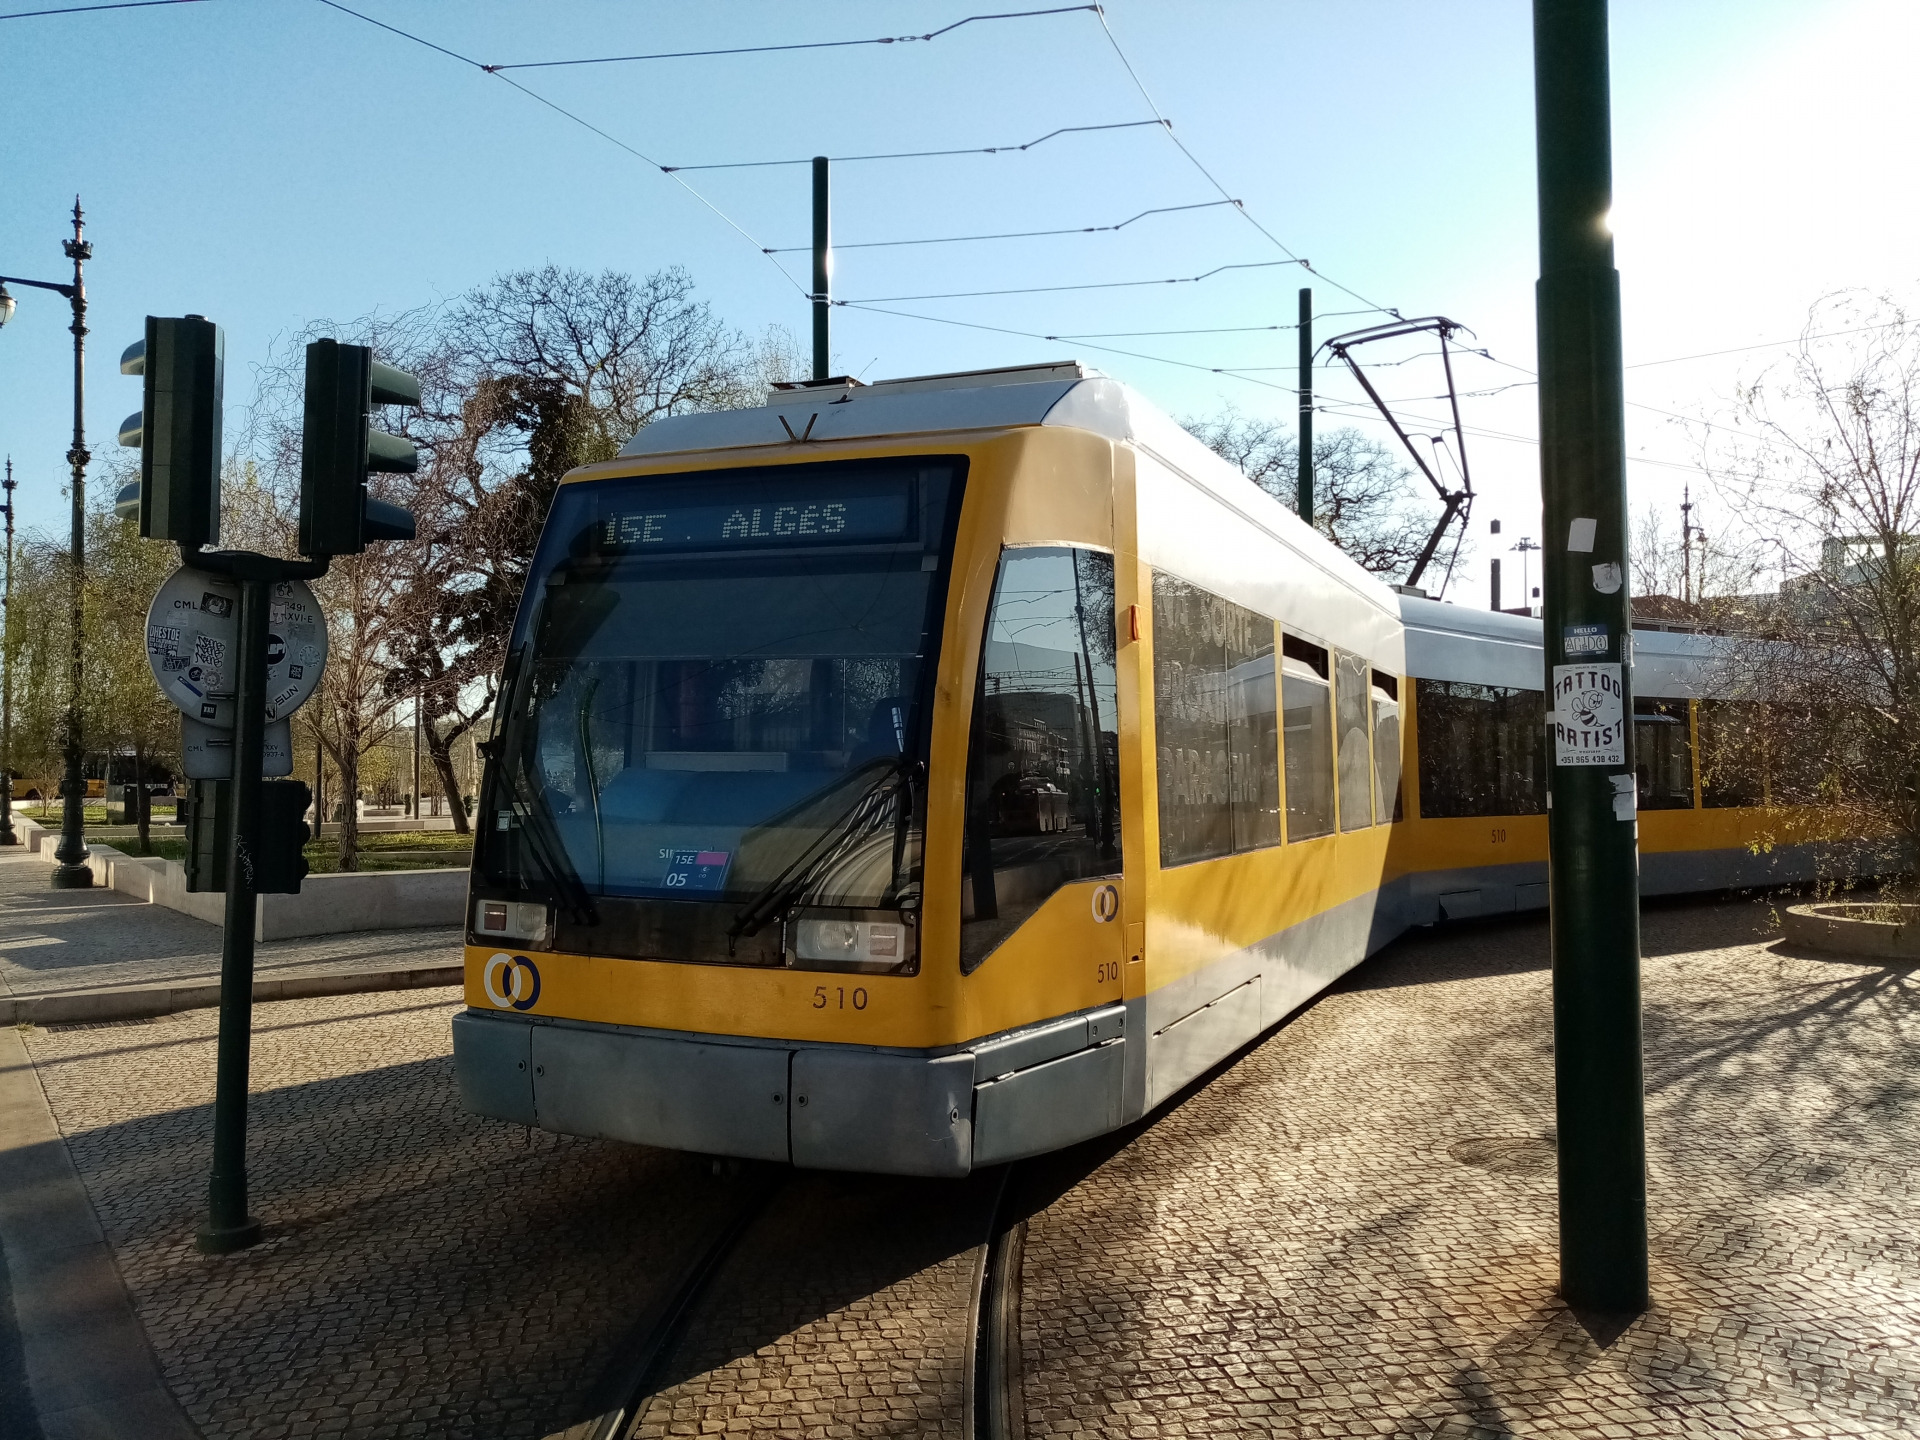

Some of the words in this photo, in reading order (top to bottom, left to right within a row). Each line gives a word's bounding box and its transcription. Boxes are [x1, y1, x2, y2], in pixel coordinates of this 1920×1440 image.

[603, 514, 666, 544] 15E
[722, 504, 846, 538] ALGÉS
[174, 601, 198, 609] CML
[285, 613, 313, 623] XVI-E
[275, 685, 299, 705] SUN
[1555, 672, 1620, 700] TATTOO
[1557, 719, 1622, 748] ARTIST
[1491, 829, 1506, 843] 510
[675, 855, 695, 864] 15E
[666, 873, 688, 886] 05
[1098, 961, 1118, 983] 510
[812, 986, 868, 1011] 510
